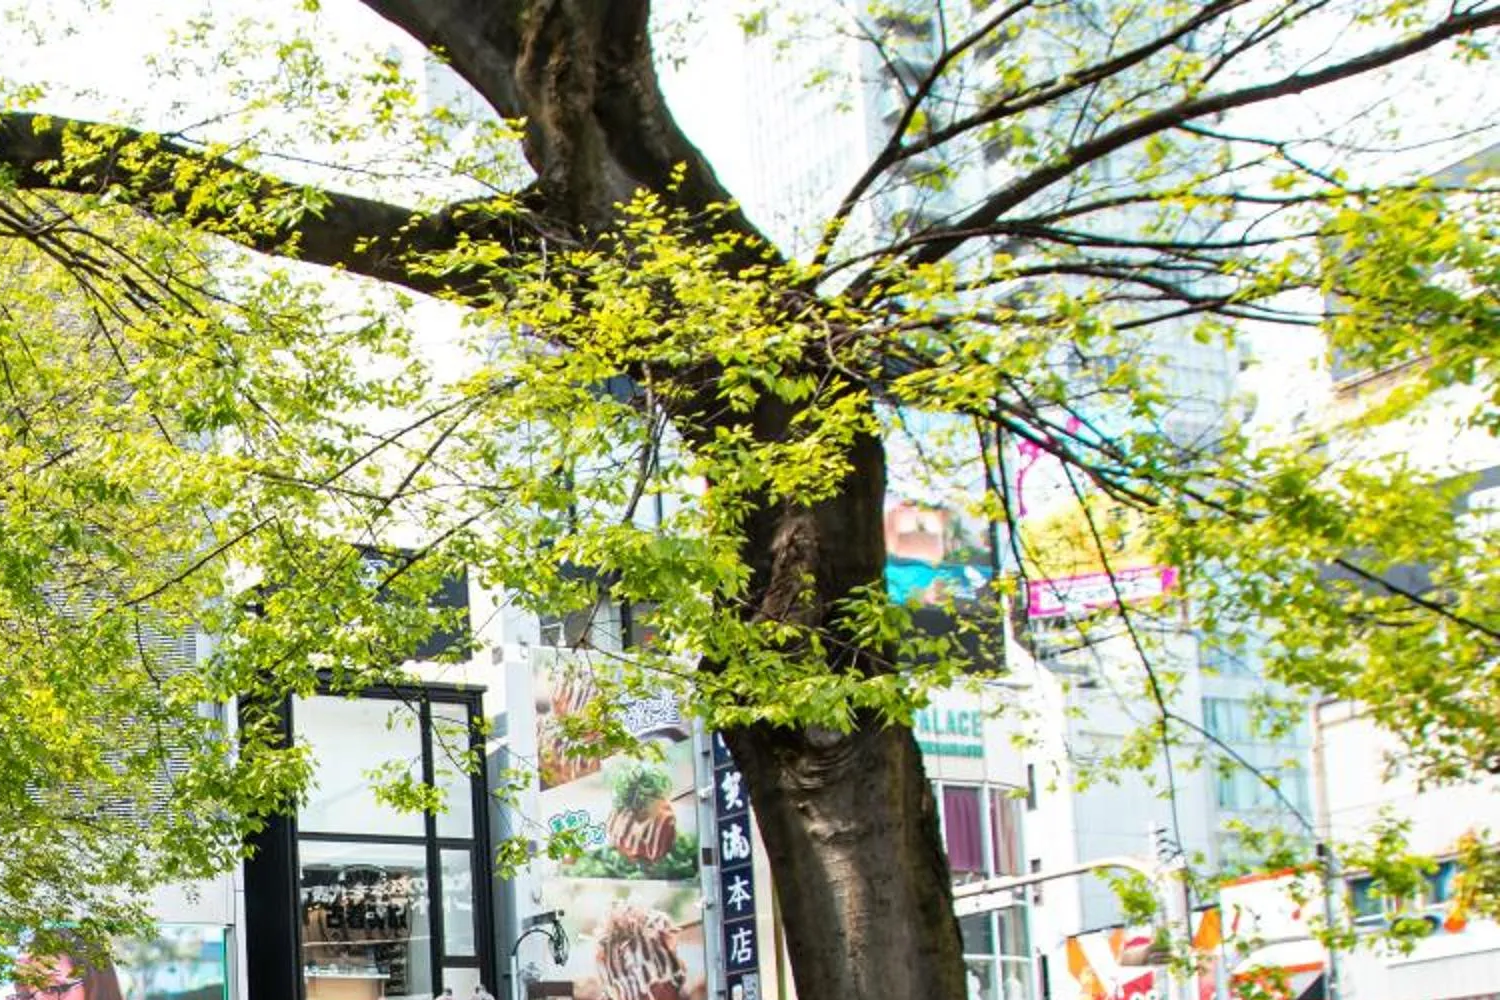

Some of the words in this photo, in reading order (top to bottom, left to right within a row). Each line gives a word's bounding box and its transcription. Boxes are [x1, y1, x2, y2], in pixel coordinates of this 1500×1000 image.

[917, 708, 983, 736] ALACE
[718, 731, 753, 964] 賀流本店
